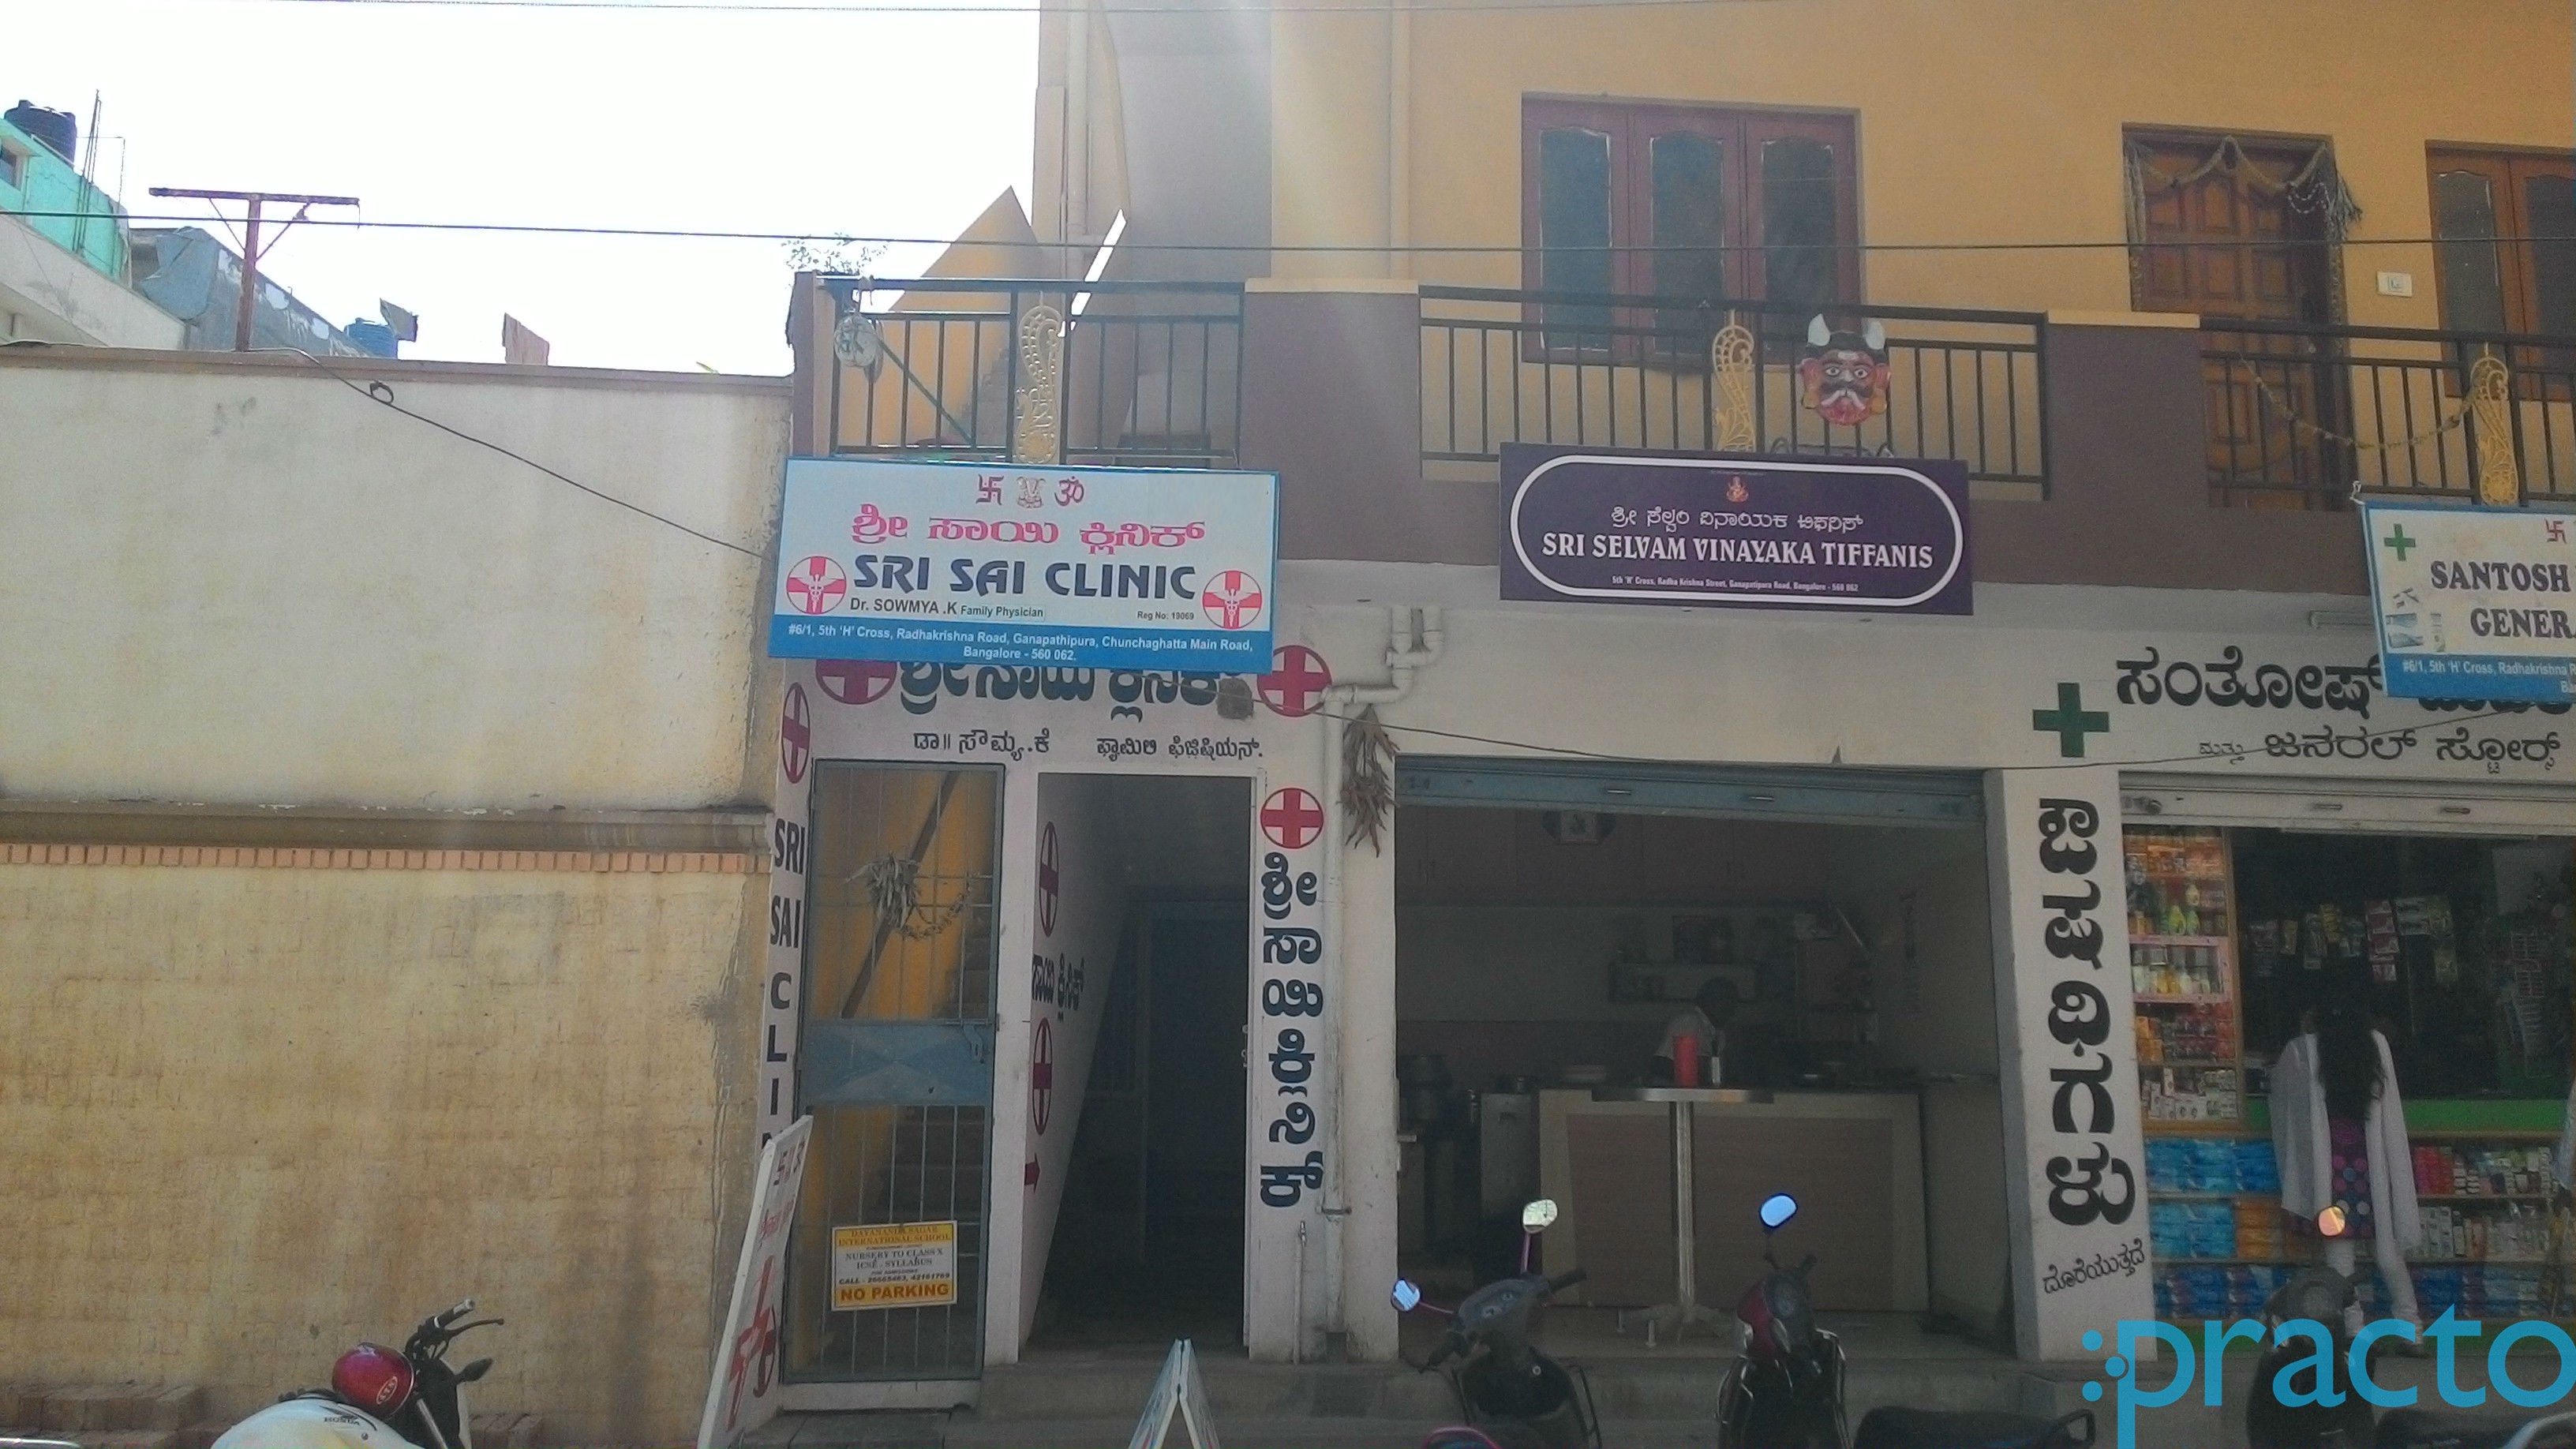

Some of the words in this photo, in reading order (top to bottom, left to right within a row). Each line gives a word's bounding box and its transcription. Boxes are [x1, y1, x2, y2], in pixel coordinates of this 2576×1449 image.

[852, 504, 908, 544] ಶ್ರೀ
[927, 517, 1059, 543] ಸಾಯಿ
[1080, 521, 1205, 555] ಕ್ಲಿನಿಕ್
[1611, 506, 1637, 527] ಶ್ರೀ
[1700, 511, 1788, 530] ವಿನಾಯಕ
[1542, 532, 1586, 556] SRI
[1592, 534, 1687, 560] SELVAM
[1693, 537, 1816, 564] VINAYAKA
[1822, 541, 1933, 568] TIFFANIS
[854, 554, 930, 593] SRI
[949, 559, 1025, 597] SAI
[1045, 563, 1196, 599] CLINIC
[1679, 578, 1704, 586] Krishna
[1793, 582, 1826, 591] Bangalore
[2431, 560, 2571, 592] SANTOSH
[851, 597, 869, 611] Dr.
[874, 598, 939, 614] SOWMYA
[960, 605, 992, 617] Family
[996, 606, 1043, 618] Physician
[1137, 611, 1152, 620] Reg
[1155, 611, 1169, 620] No:
[1172, 612, 1194, 620] 19069
[788, 623, 815, 637] #6/1,
[818, 624, 837, 635] 5th
[857, 626, 893, 639] Cross,
[897, 628, 974, 642] Radhakrishna
[977, 631, 1010, 645] Road,
[1013, 632, 1099, 648] Ganapathipura,
[1102, 636, 1187, 651] Chunchaghatta
[1190, 638, 1218, 650] Main
[1220, 639, 1253, 652] Road,
[2470, 608, 2576, 638] GENER
[964, 646, 1021, 659] Bangalore
[1032, 649, 1050, 659] 560
[1054, 650, 1076, 661] 062.
[2430, 660, 2445, 672] 5th
[2463, 661, 2496, 675] Cross,
[2499, 661, 2566, 676] Radhakrishna
[2265, 724, 2417, 760] ಜನರಲ್
[775, 818, 806, 874] SRI
[1261, 852, 1317, 919] ಶ್ರೀ
[770, 895, 802, 948] SAI
[762, 972, 792, 1150] CLI
[839, 1235, 910, 1246] INTERNATIONAL
[845, 1251, 889, 1261] NURSERY
[907, 1249, 935, 1257] CLASS
[885, 1258, 932, 1267] SYLLABUS
[841, 1287, 866, 1301] NO
[871, 1283, 949, 1300] PARKING
